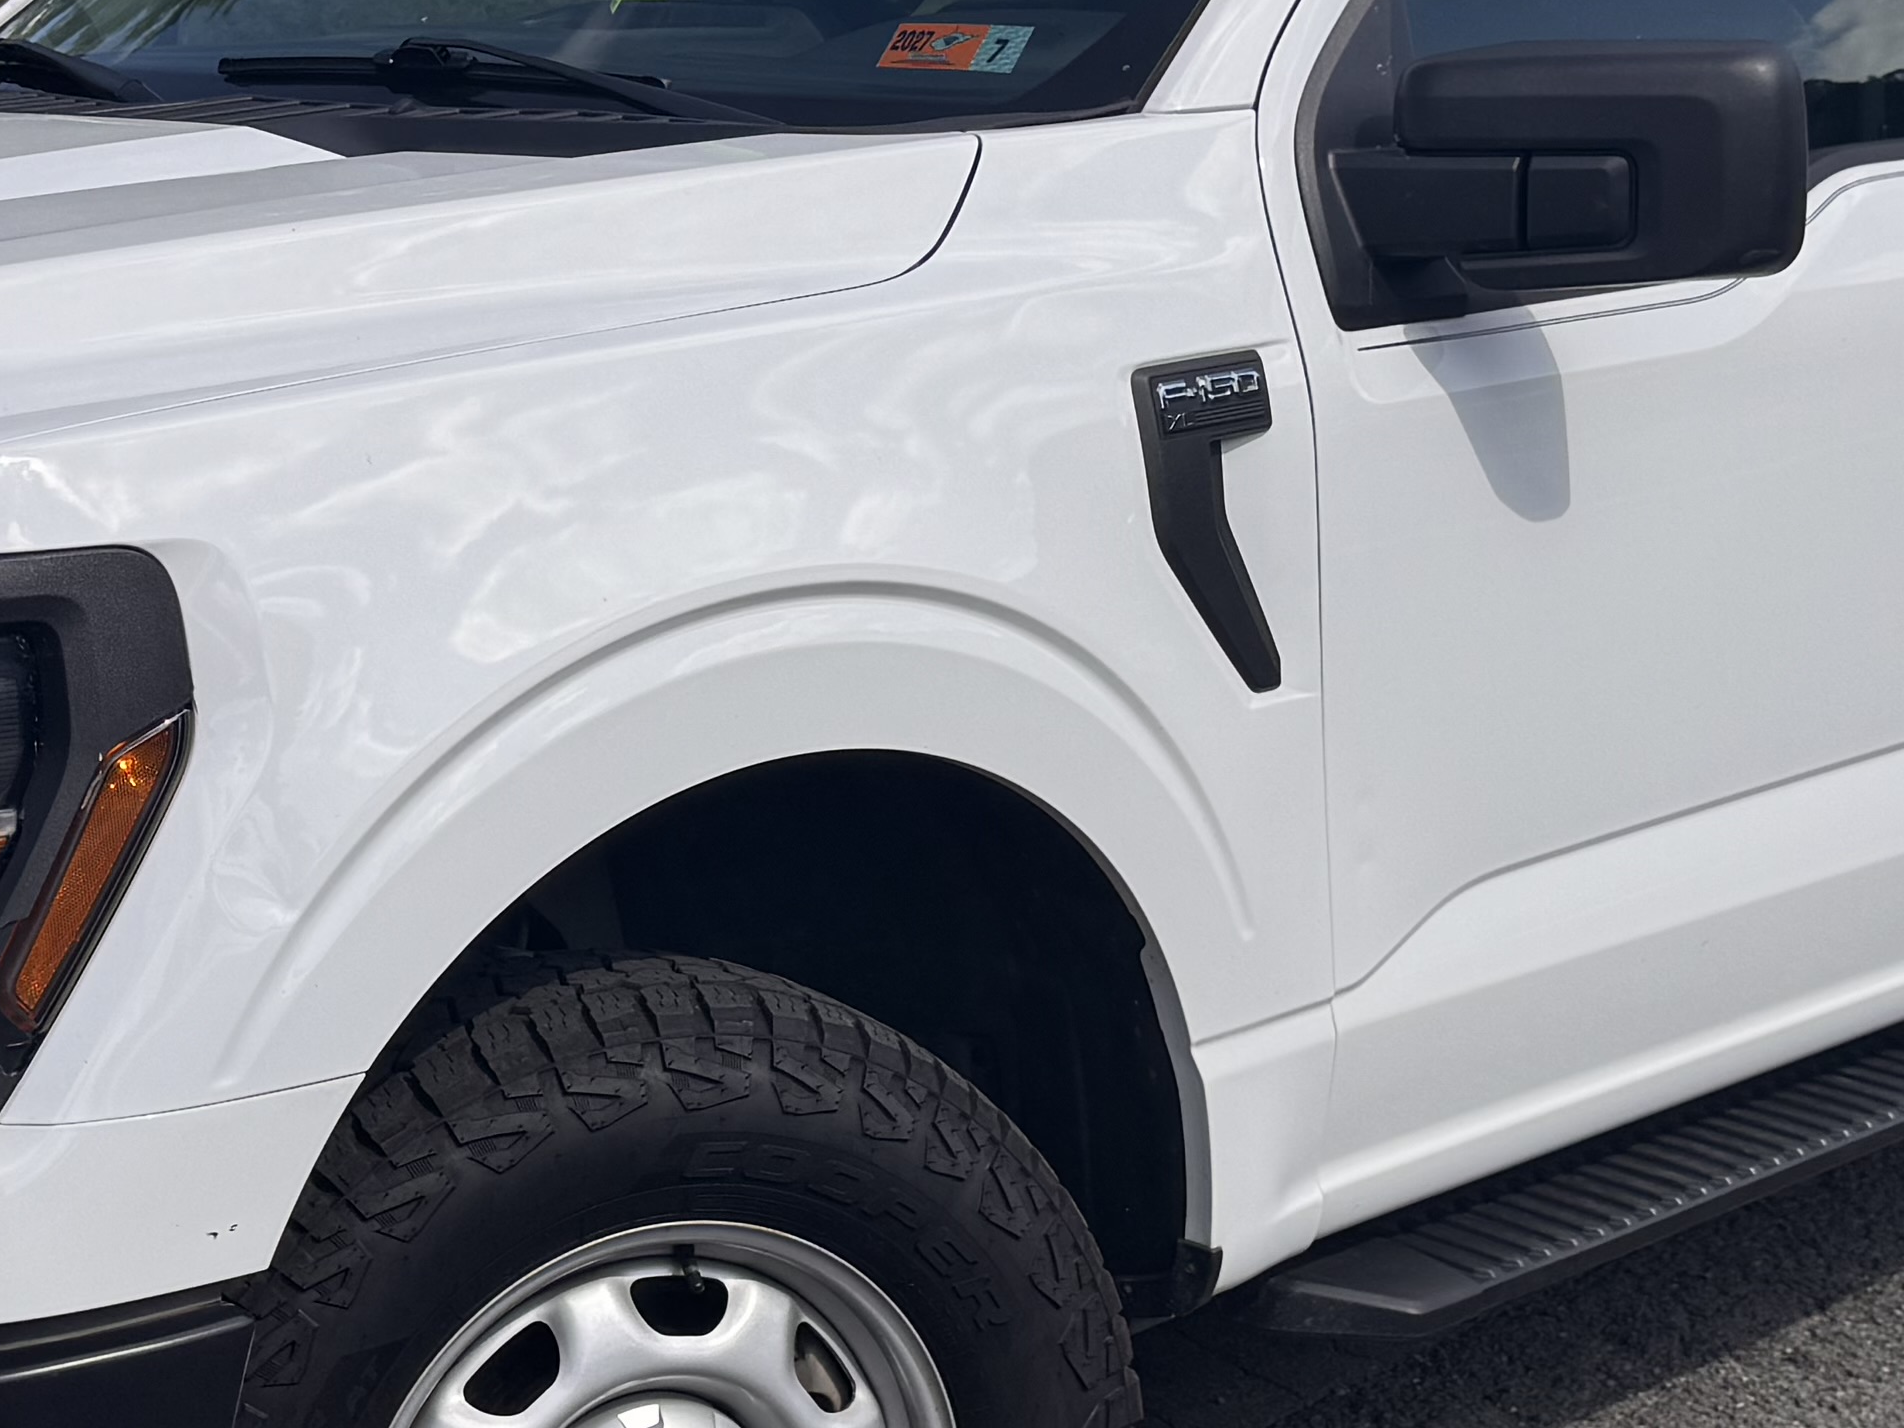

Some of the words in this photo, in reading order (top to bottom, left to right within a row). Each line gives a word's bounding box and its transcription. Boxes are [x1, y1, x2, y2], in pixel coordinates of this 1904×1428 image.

[890, 29, 936, 52] 2027
[986, 38, 1010, 63] 7
[1156, 368, 1260, 409] F-150
[1167, 412, 1194, 430] XL
[680, 1140, 1012, 1333] COOPER
